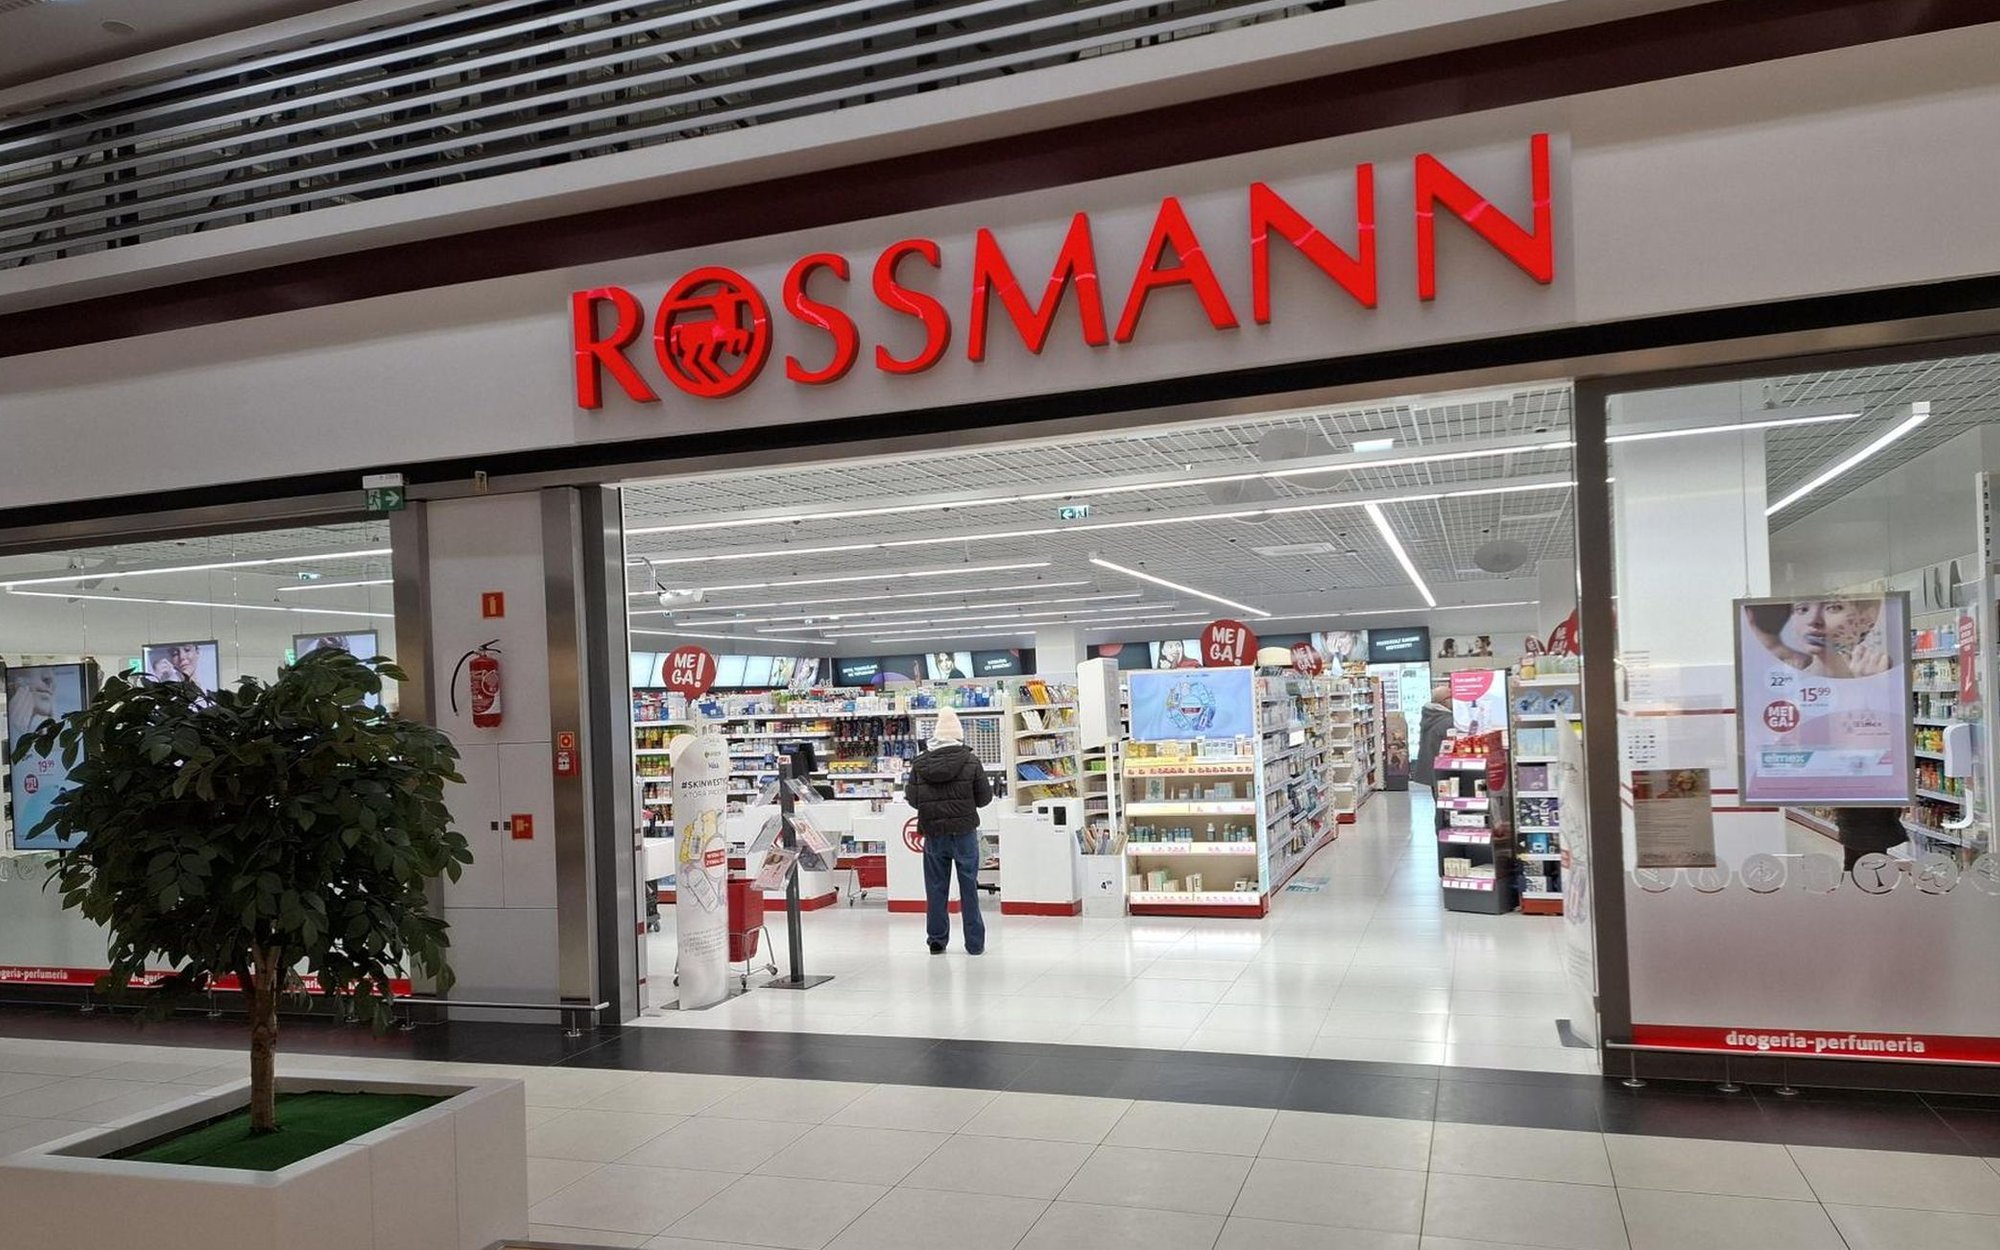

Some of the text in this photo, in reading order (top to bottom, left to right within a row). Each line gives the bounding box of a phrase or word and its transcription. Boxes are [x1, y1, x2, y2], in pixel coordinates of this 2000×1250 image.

[572, 133, 1554, 410] ROSSMANN
[1211, 626, 1236, 644] ME
[674, 653, 697, 669] ME
[1768, 706, 1788, 717] ME
[1726, 1030, 1925, 1054] drogeria-perfumeria
